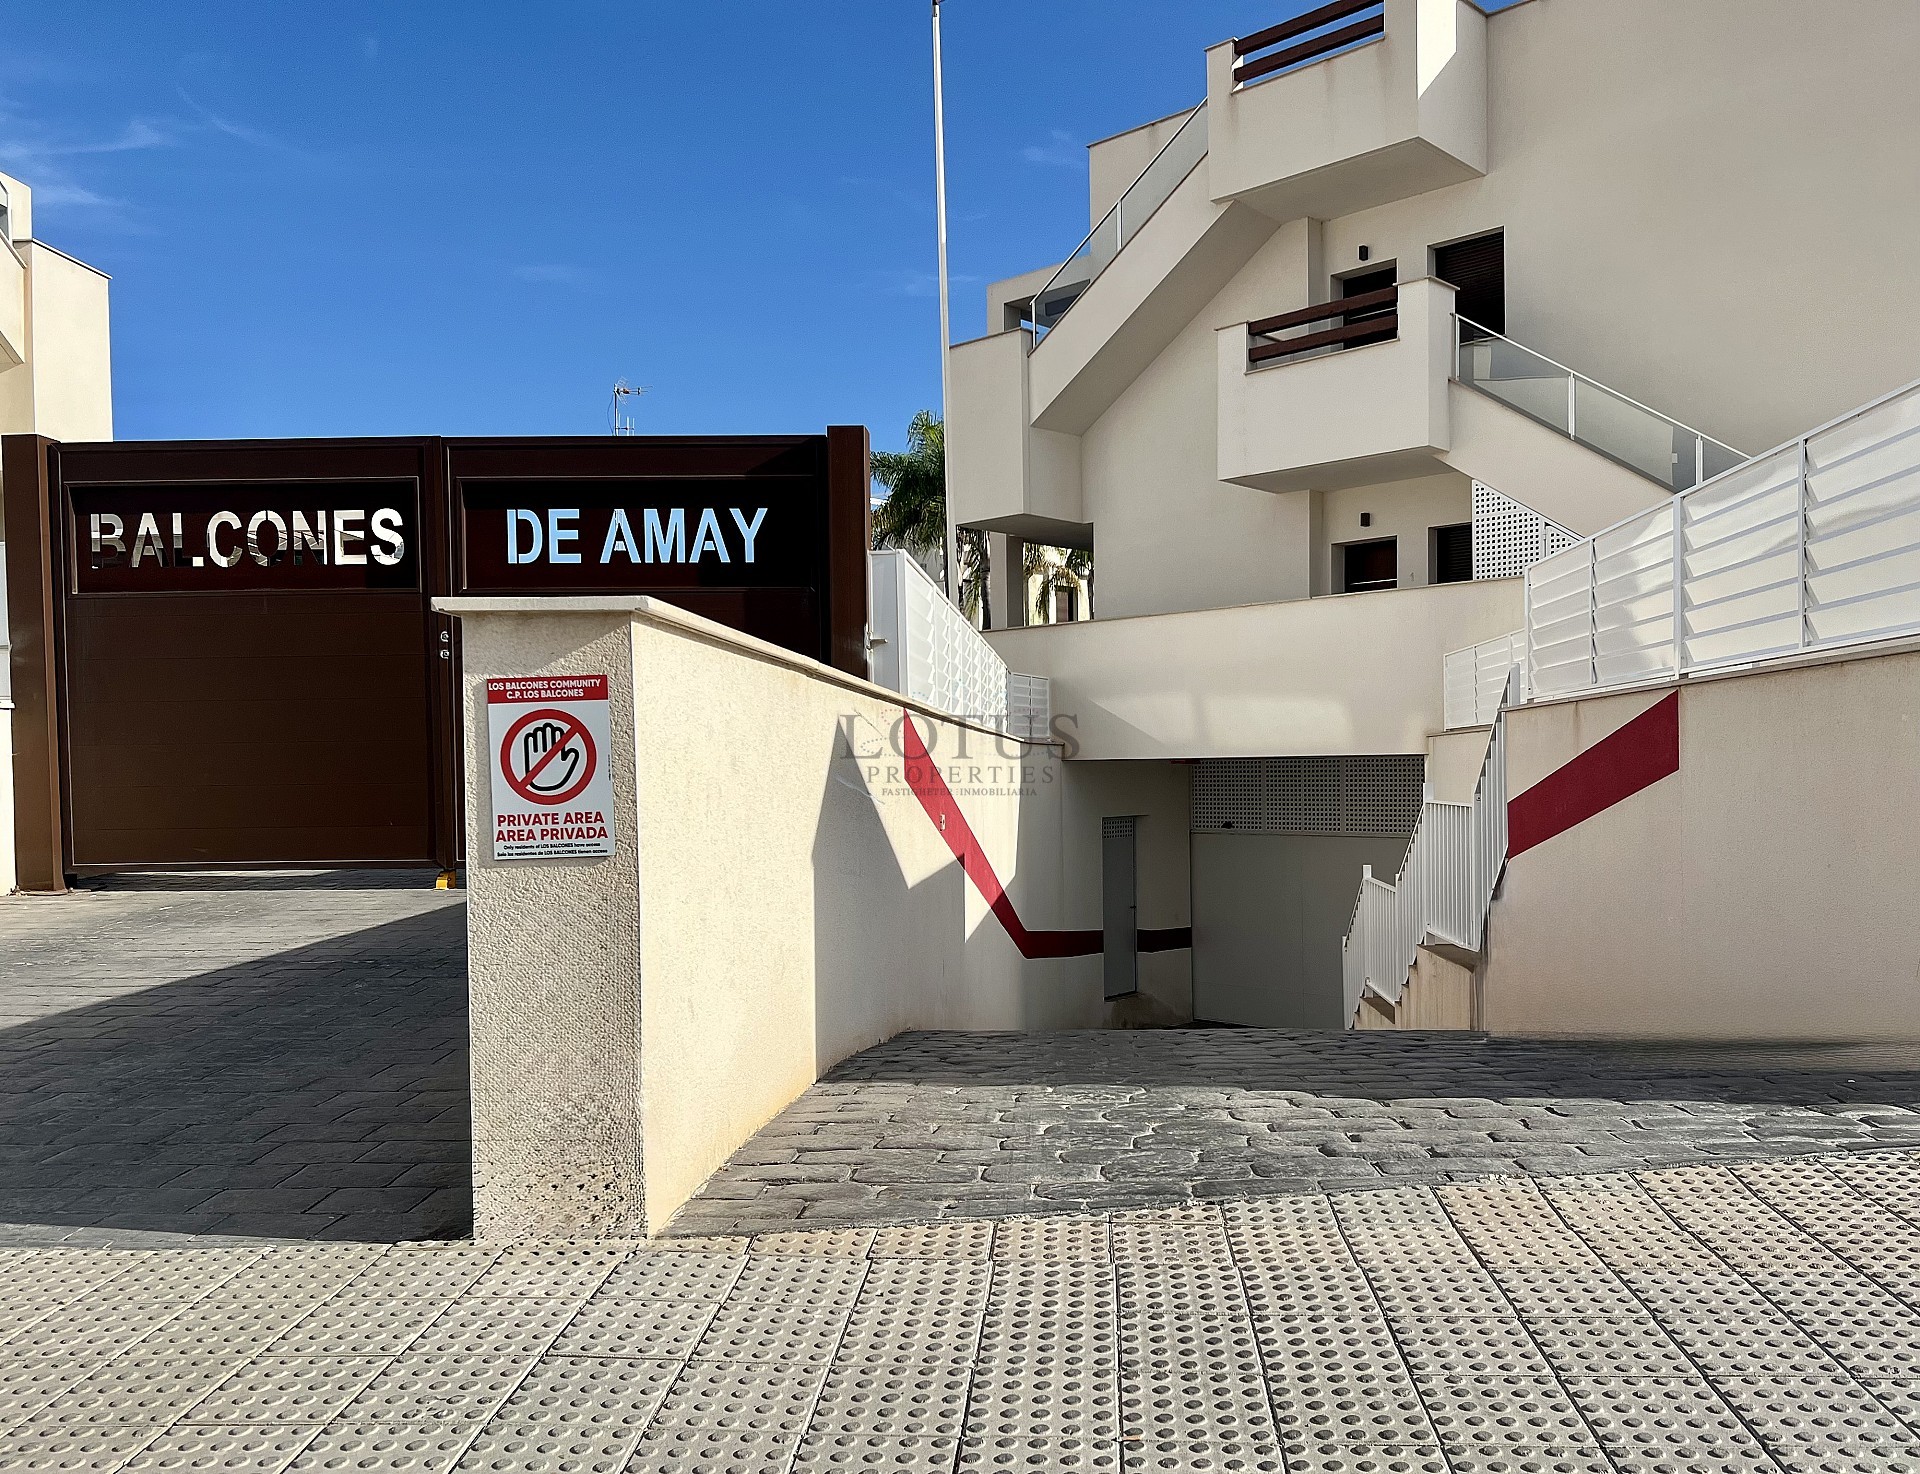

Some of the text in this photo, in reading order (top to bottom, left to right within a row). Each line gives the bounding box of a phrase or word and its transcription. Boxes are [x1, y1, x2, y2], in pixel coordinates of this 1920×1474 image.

[91, 508, 768, 569] BALCONES DE AMAY
[488, 679, 601, 691] LOS BALCONES COMMUNITY
[506, 689, 584, 699] C.P. LOS BALCONES
[497, 811, 605, 827] PRIVATE AREA
[495, 826, 609, 843] AREA PRIVADA
